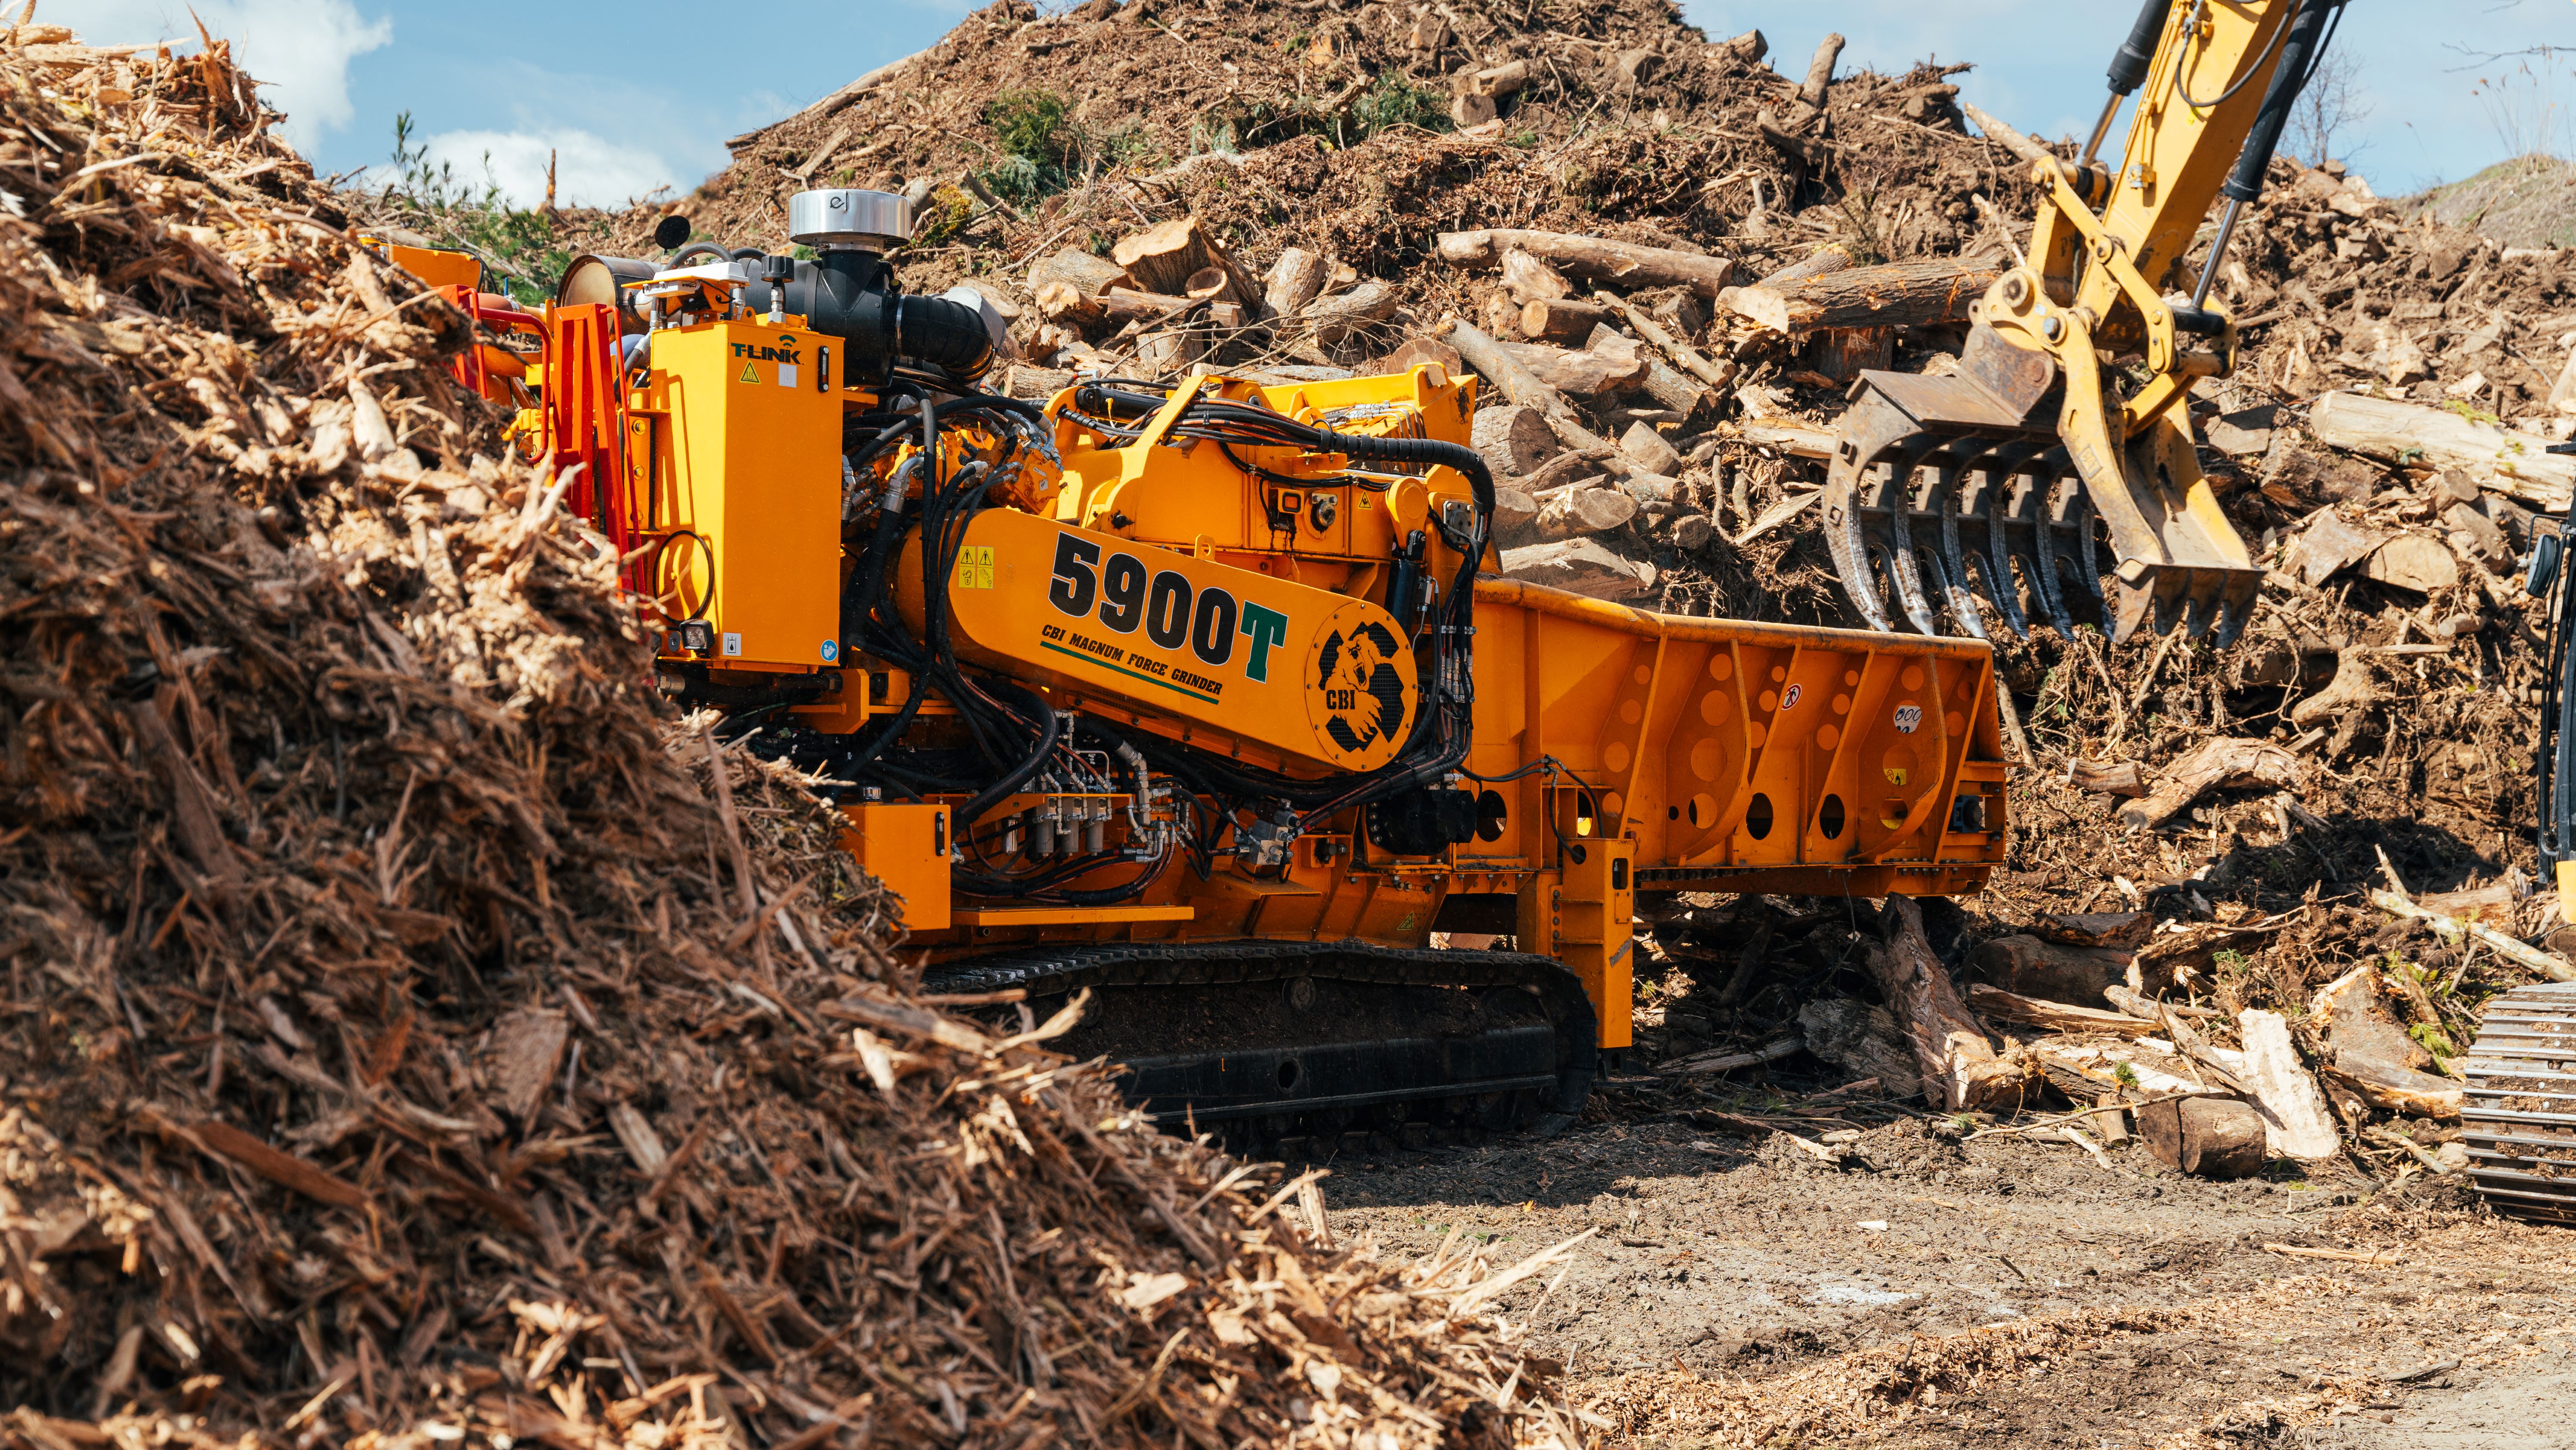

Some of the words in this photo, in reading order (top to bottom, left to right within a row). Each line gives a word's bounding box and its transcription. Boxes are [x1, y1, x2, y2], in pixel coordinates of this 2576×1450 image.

[731, 342, 801, 365] T-LINK
[1048, 530, 1289, 684] 5900T
[1042, 624, 1066, 641] CBI
[1069, 633, 1124, 662] MAGNUM
[1127, 653, 1169, 676] FORCE
[1171, 668, 1223, 695] GRINDER
[1326, 690, 1355, 710] CBI
